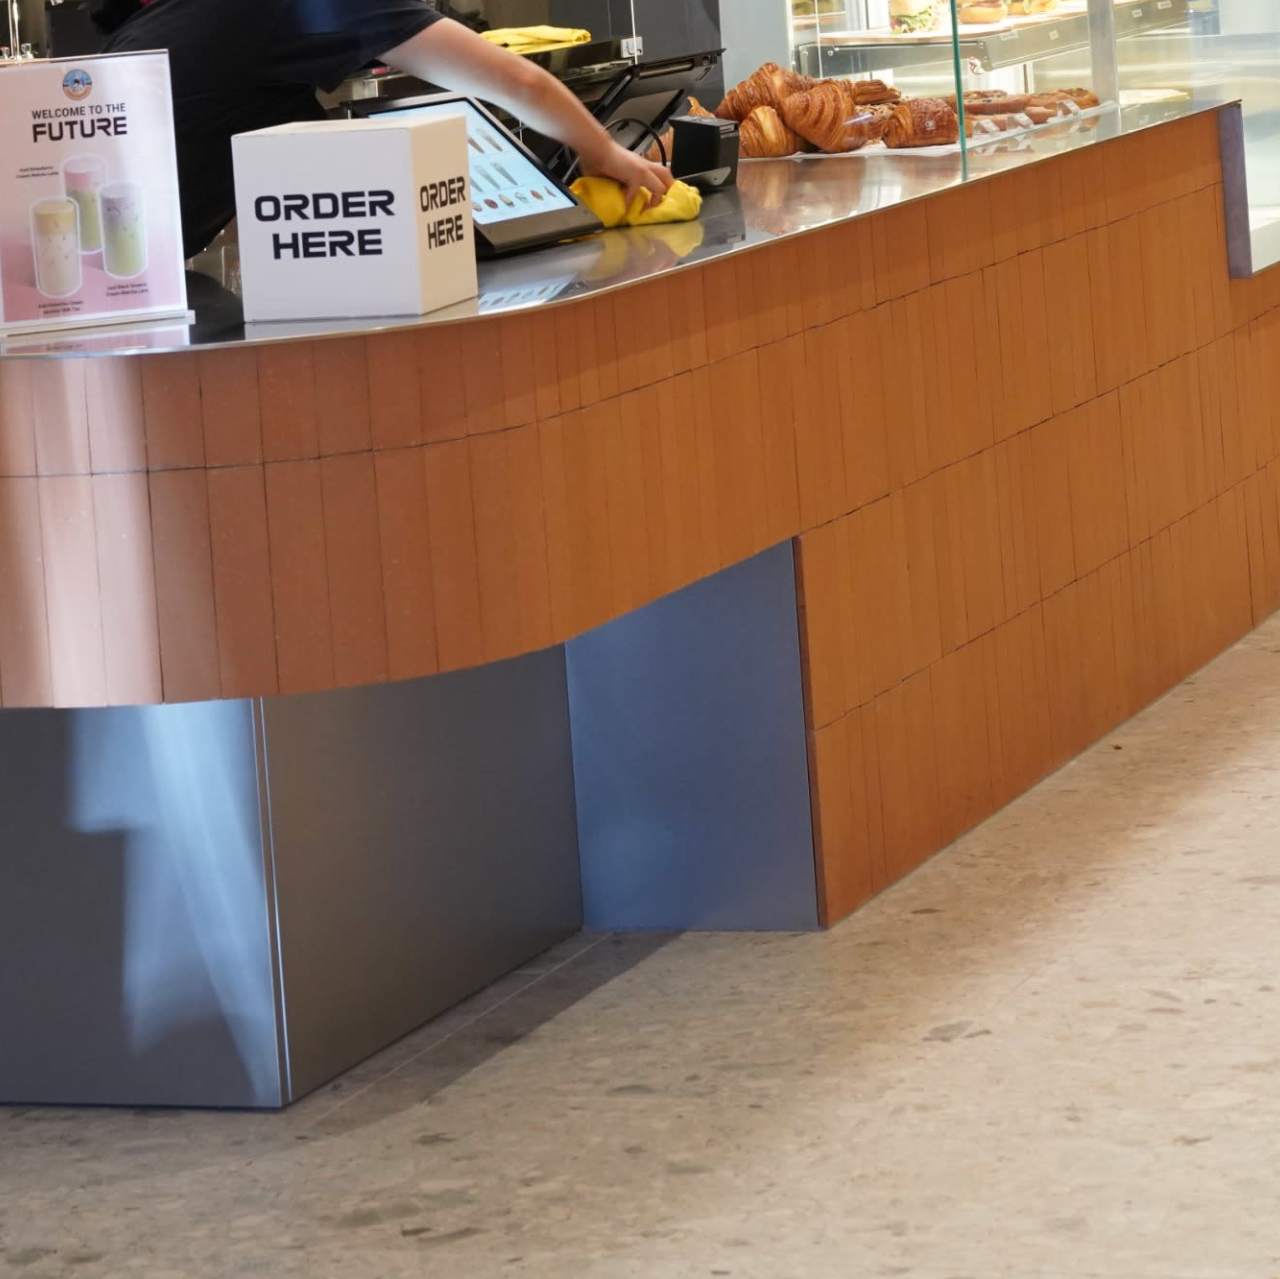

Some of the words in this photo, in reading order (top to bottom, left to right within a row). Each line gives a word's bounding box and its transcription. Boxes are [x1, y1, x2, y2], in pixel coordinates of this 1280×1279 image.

[31, 106, 86, 120] WELCOME
[88, 104, 103, 115] TO
[105, 102, 126, 113] THE
[32, 116, 128, 143] FUTURE
[254, 189, 395, 222] ORDER
[420, 175, 466, 212] ORDER
[272, 228, 383, 260] HERE
[427, 213, 464, 250] HERE
